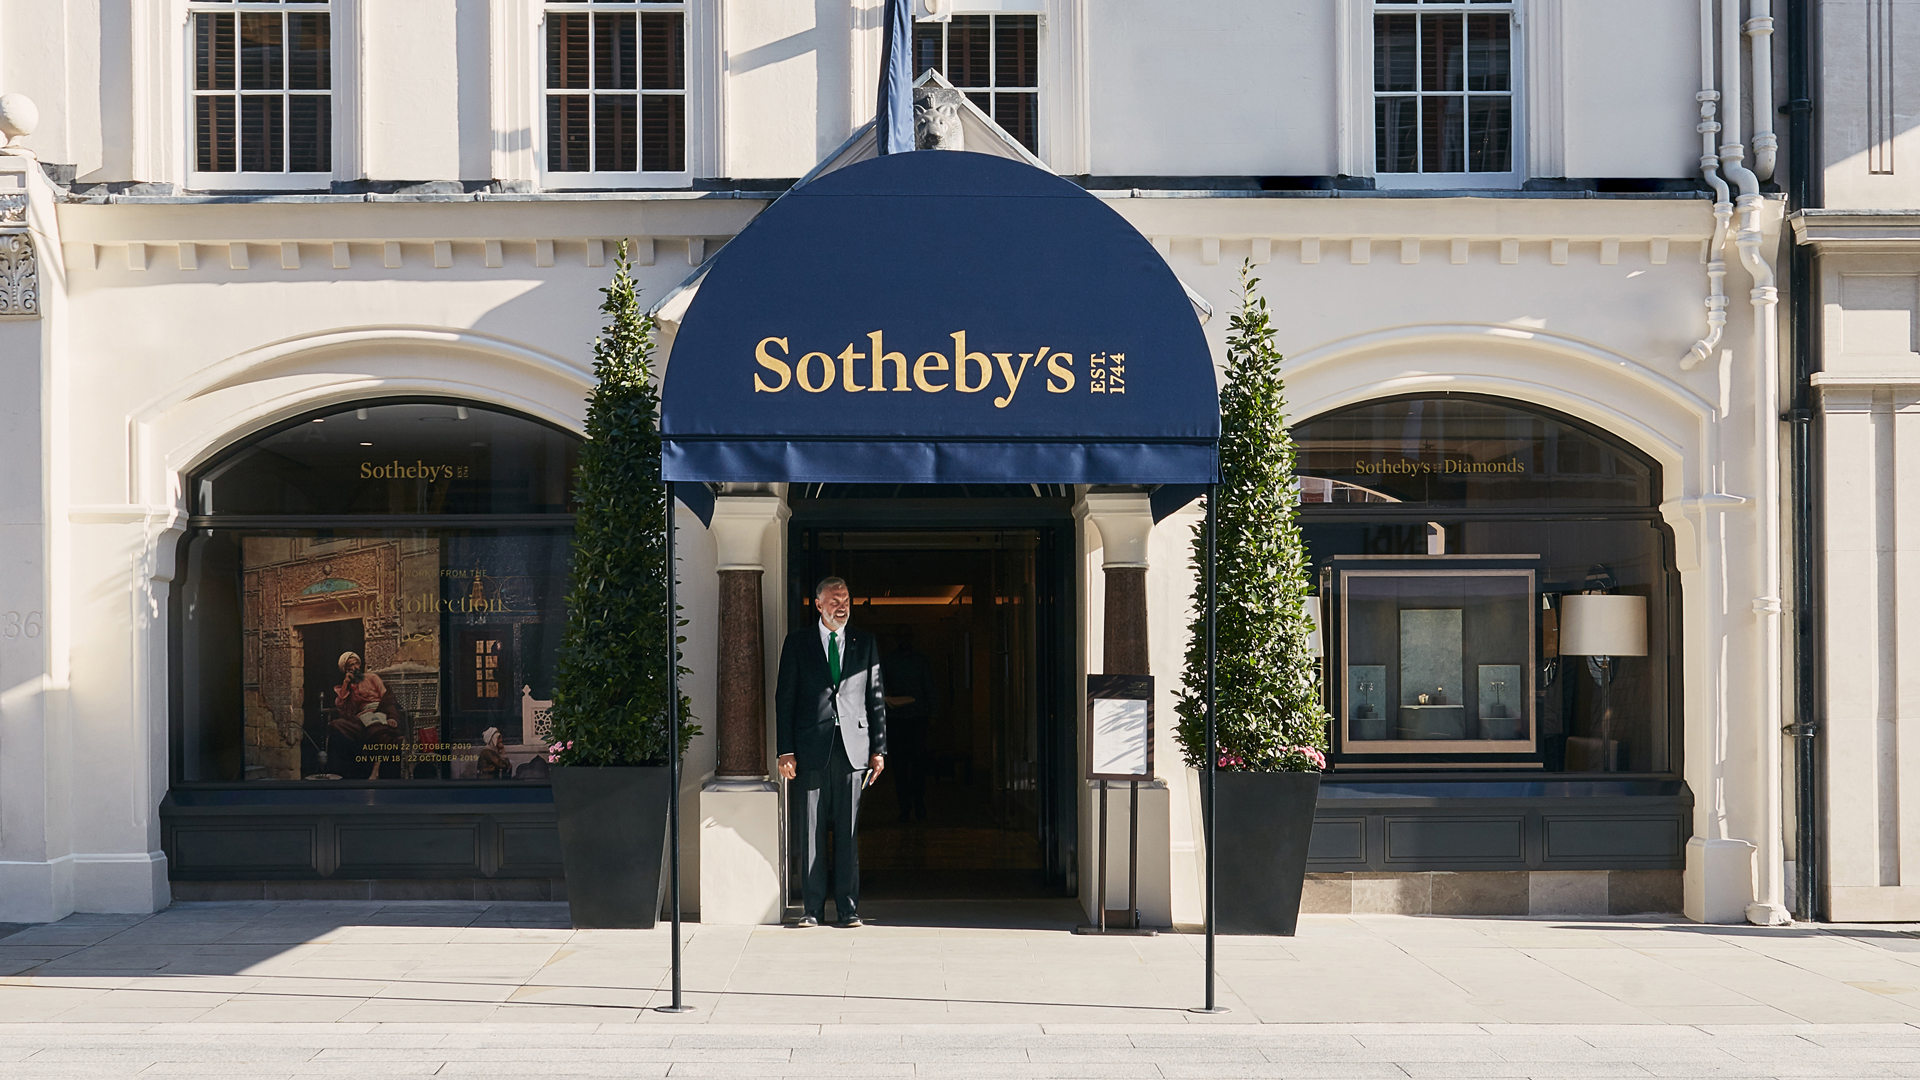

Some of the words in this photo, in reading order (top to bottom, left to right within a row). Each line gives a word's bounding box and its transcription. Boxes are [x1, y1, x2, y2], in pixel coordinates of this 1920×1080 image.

[754, 330, 1076, 408] Sotheby's
[1090, 351, 1106, 394] EST.
[1109, 352, 1125, 394] 1744
[360, 460, 453, 483] Sotheby's
[1355, 459, 1431, 477] Sotheby's
[1444, 458, 1525, 474] Diamonds
[404, 569, 437, 578] WORKS
[440, 569, 467, 578] FROM
[469, 569, 488, 578] THE
[389, 593, 503, 613] Collection
[2, 611, 42, 639] 36
[362, 743, 399, 751] AUCTION
[355, 755, 367, 763] ON
[408, 754, 417, 762] 22
[419, 754, 457, 762] OCTOBER
[459, 754, 479, 762] 2019
